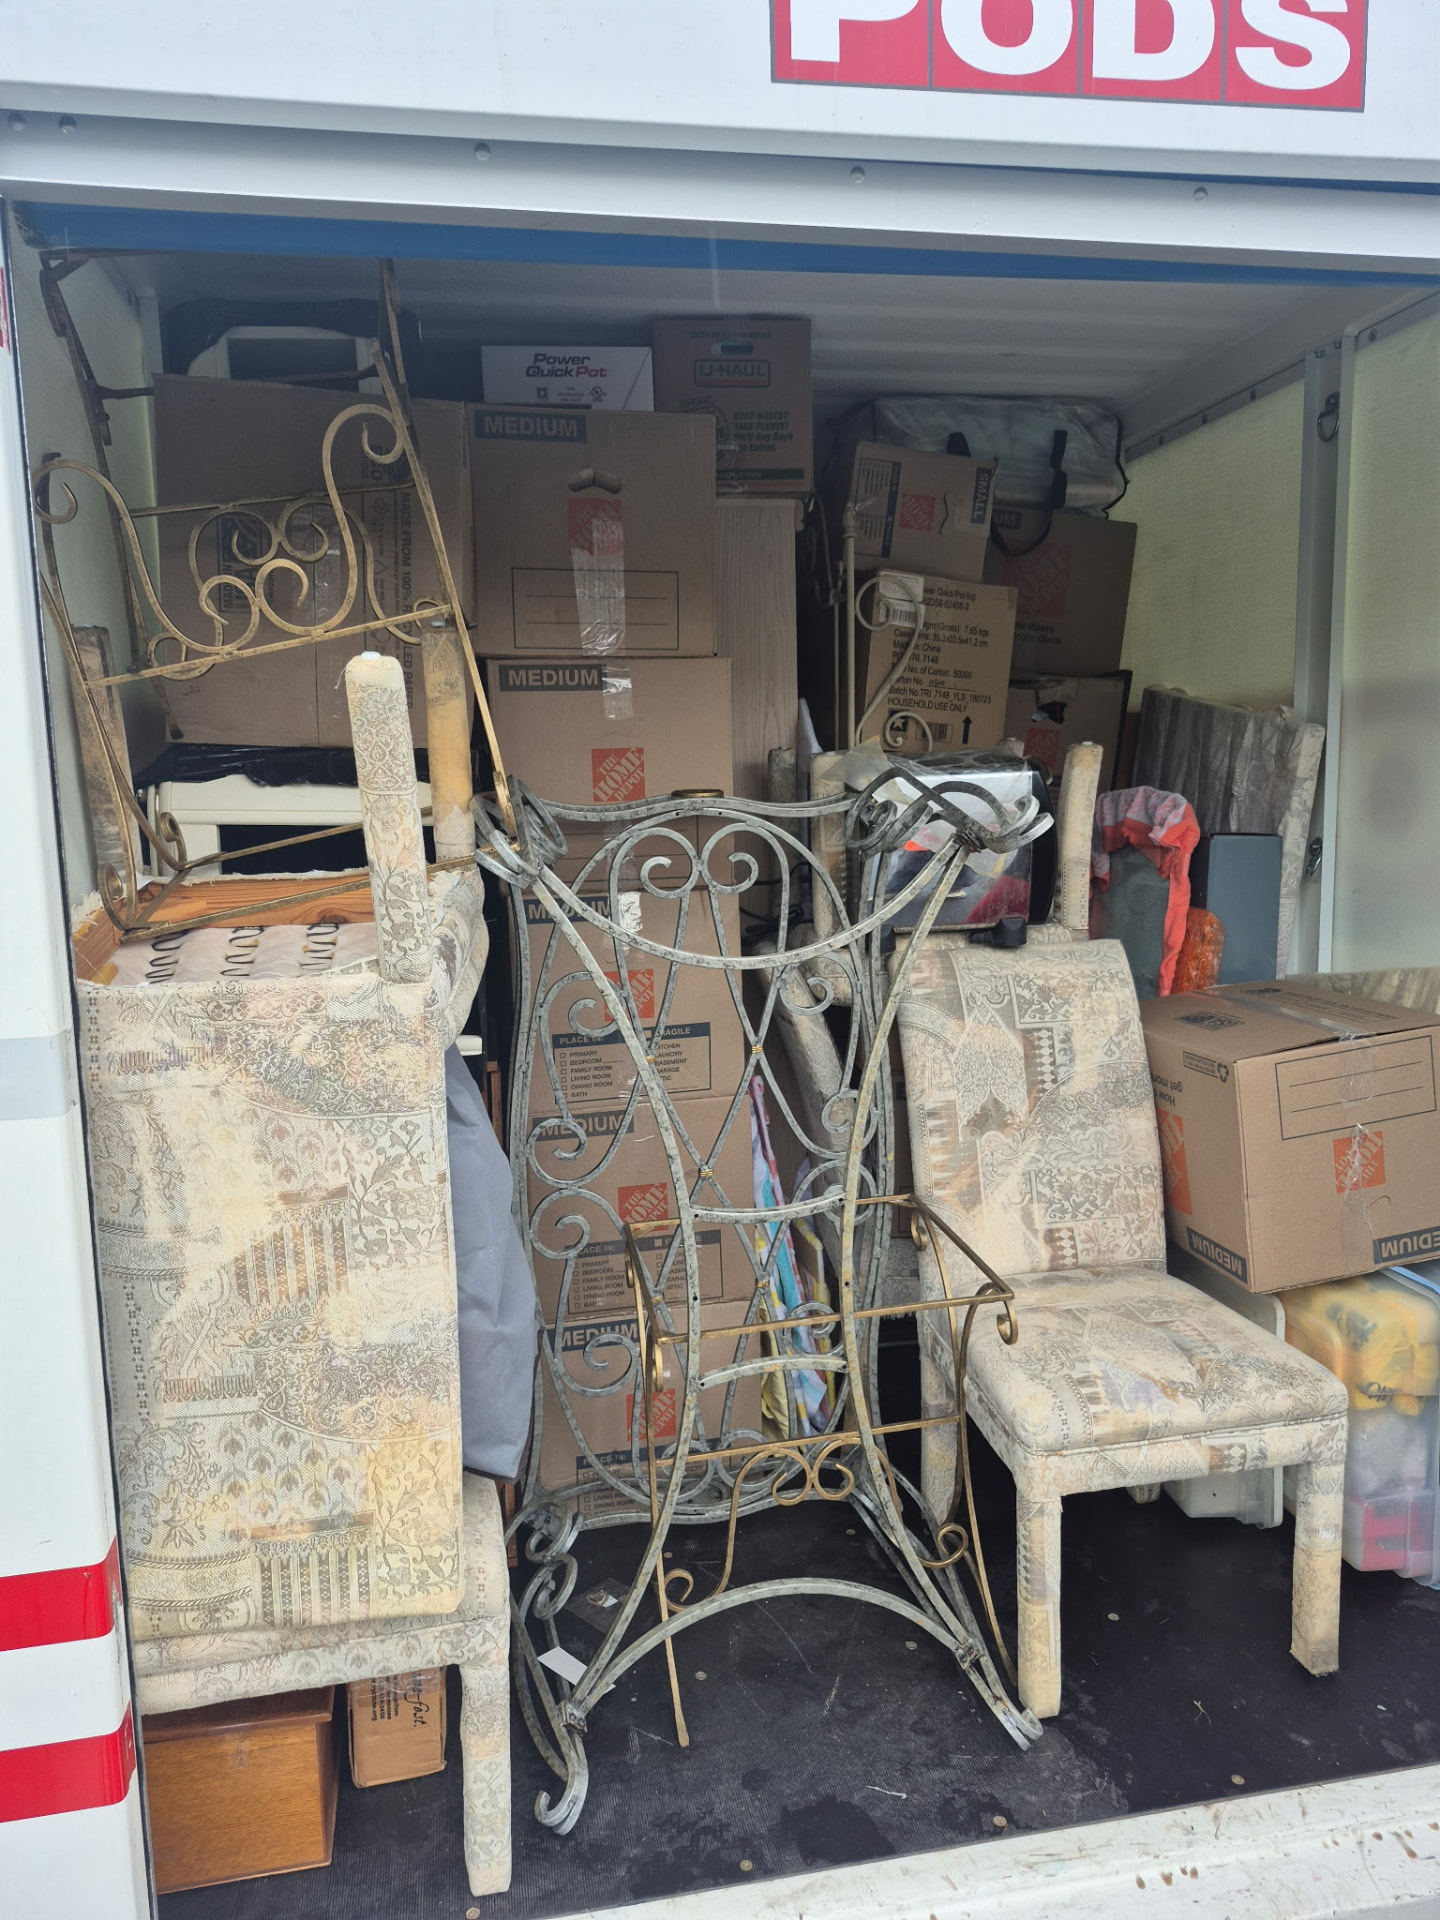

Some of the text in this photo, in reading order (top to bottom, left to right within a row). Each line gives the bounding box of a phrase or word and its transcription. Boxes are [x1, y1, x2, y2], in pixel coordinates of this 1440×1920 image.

[790, 0, 1351, 91] PODS
[533, 353, 591, 366] Power
[698, 363, 767, 377] U-HAUL
[484, 415, 578, 437] MEDIUM
[756, 432, 772, 443] Buy
[973, 472, 989, 519] SMALL
[401, 491, 412, 528] MADE
[401, 531, 412, 567] FROM
[401, 570, 413, 601] 100%
[922, 643, 941, 653] China
[508, 669, 599, 687] MEDIUM
[887, 697, 969, 714] HOUSEHOLD USE ONLY
[596, 753, 619, 776] THE
[592, 748, 645, 803] HOME
[614, 768, 645, 802] DEPOT
[559, 1036, 589, 1046] PLACE
[569, 1050, 599, 1059] PRIMARY
[569, 1058, 602, 1067] BEDROOM
[570, 1064, 613, 1075] FAMILY ROOM
[570, 1072, 611, 1082] LIVING ROOM
[570, 1080, 613, 1091] DINING ROOM
[571, 1091, 588, 1099] BATH
[1159, 1092, 1177, 1107] How
[1381, 1230, 1440, 1258] EDIUM
[1190, 1232, 1242, 1278] MEDIUM
[581, 1260, 609, 1268] PRIMARY
[582, 1267, 614, 1276] BEDROOM
[583, 1273, 625, 1284] FAMILY ROOM
[583, 1282, 623, 1292] LIVING ROOM
[583, 1290, 625, 1300] DINING ROOM
